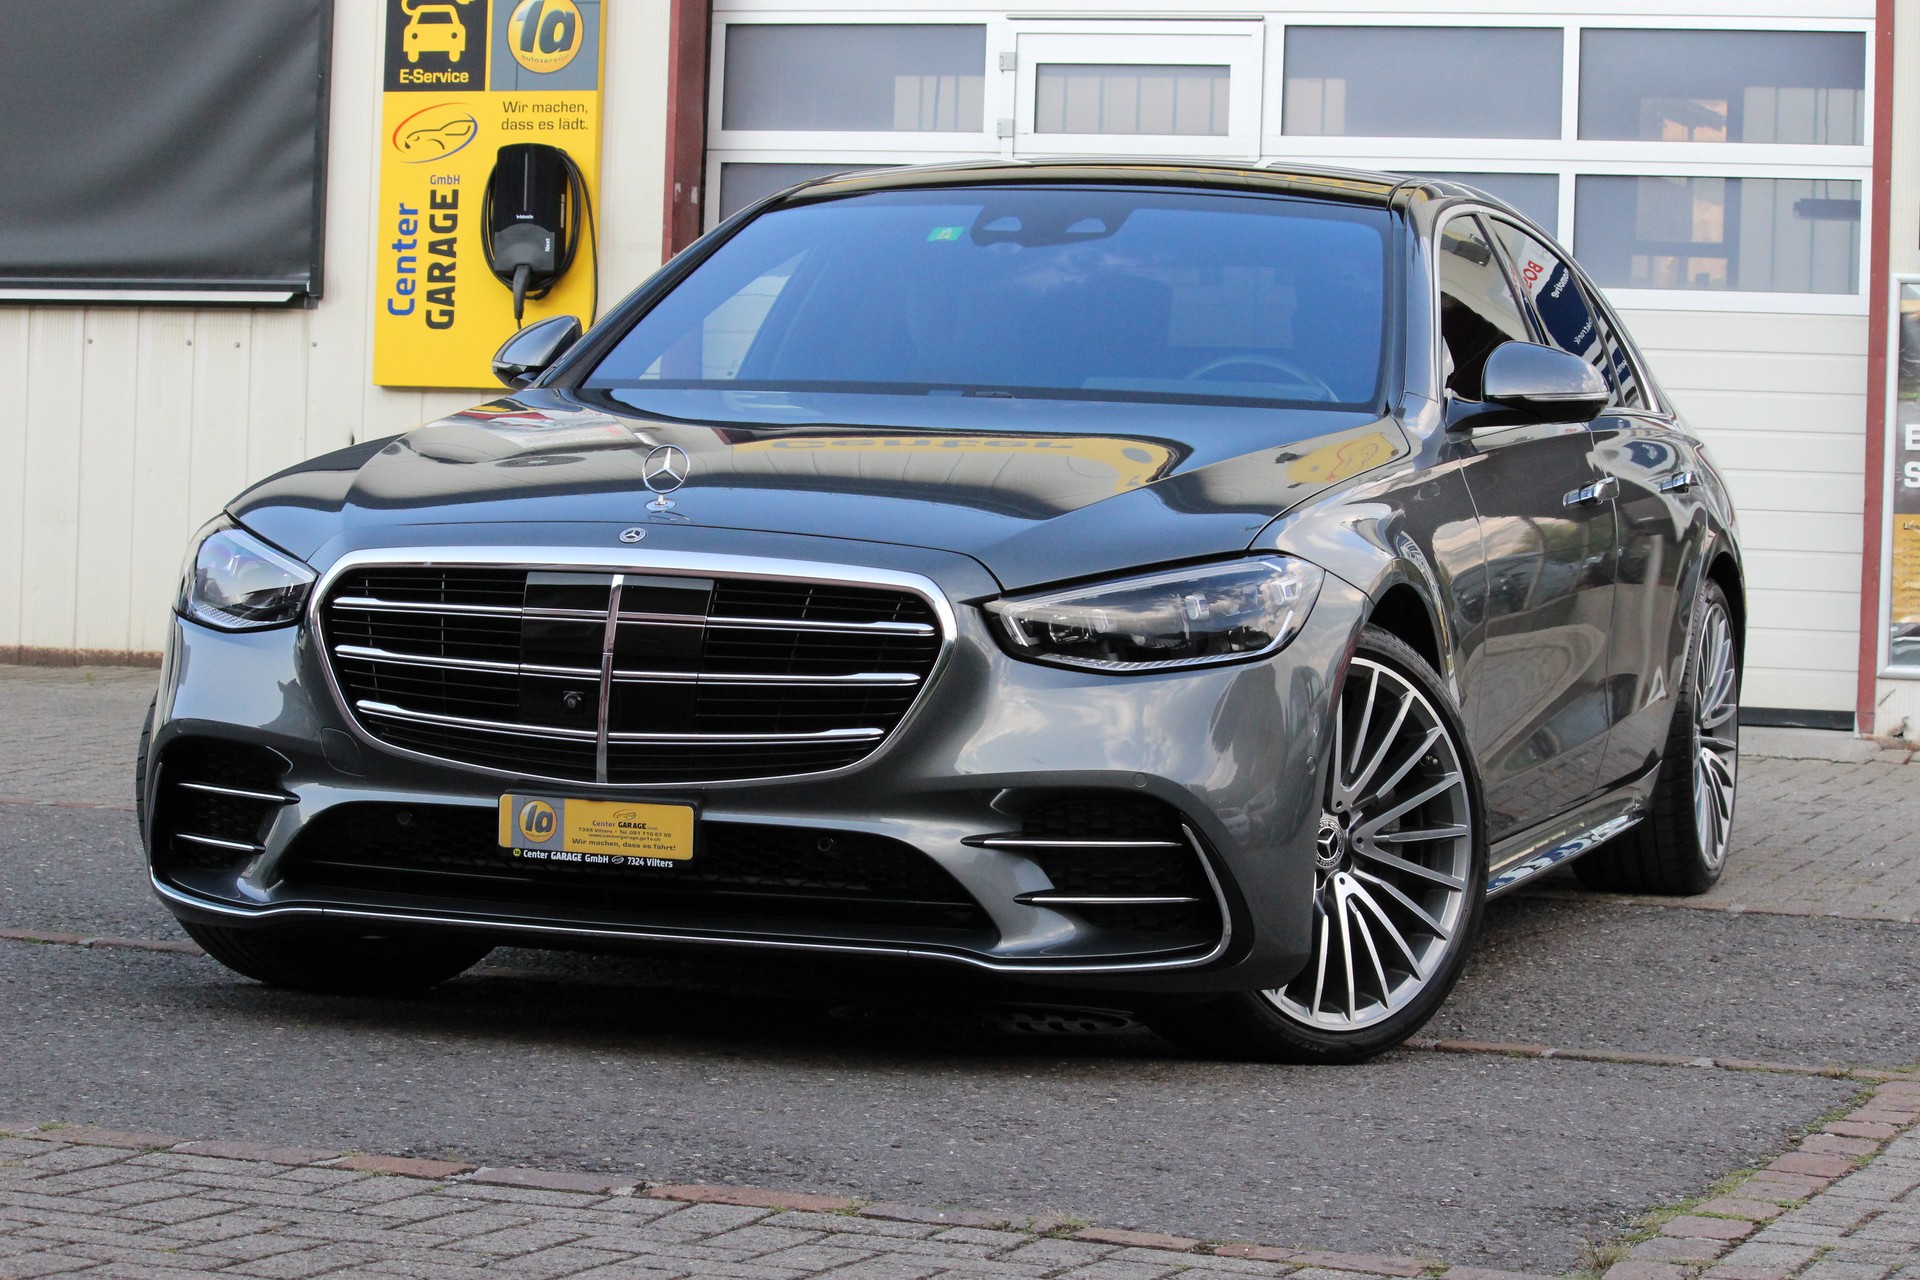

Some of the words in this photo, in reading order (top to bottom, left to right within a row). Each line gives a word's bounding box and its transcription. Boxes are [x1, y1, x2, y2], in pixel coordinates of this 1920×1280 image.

[399, 69, 469, 83] E-Service
[502, 101, 528, 114] Wir
[532, 101, 588, 115] machen,
[501, 118, 534, 131] dass
[537, 121, 554, 131] es
[558, 117, 589, 131] lädt.
[429, 174, 461, 186] GmbH
[387, 202, 419, 316] Center
[425, 189, 459, 330] GARAGE
[589, 840, 621, 848] machen,
[523, 850, 548, 859] Center
[550, 851, 582, 861] GARAGE
[585, 854, 609, 864] GmbH
[627, 857, 645, 866] 7324
[646, 857, 673, 868] Vilters
